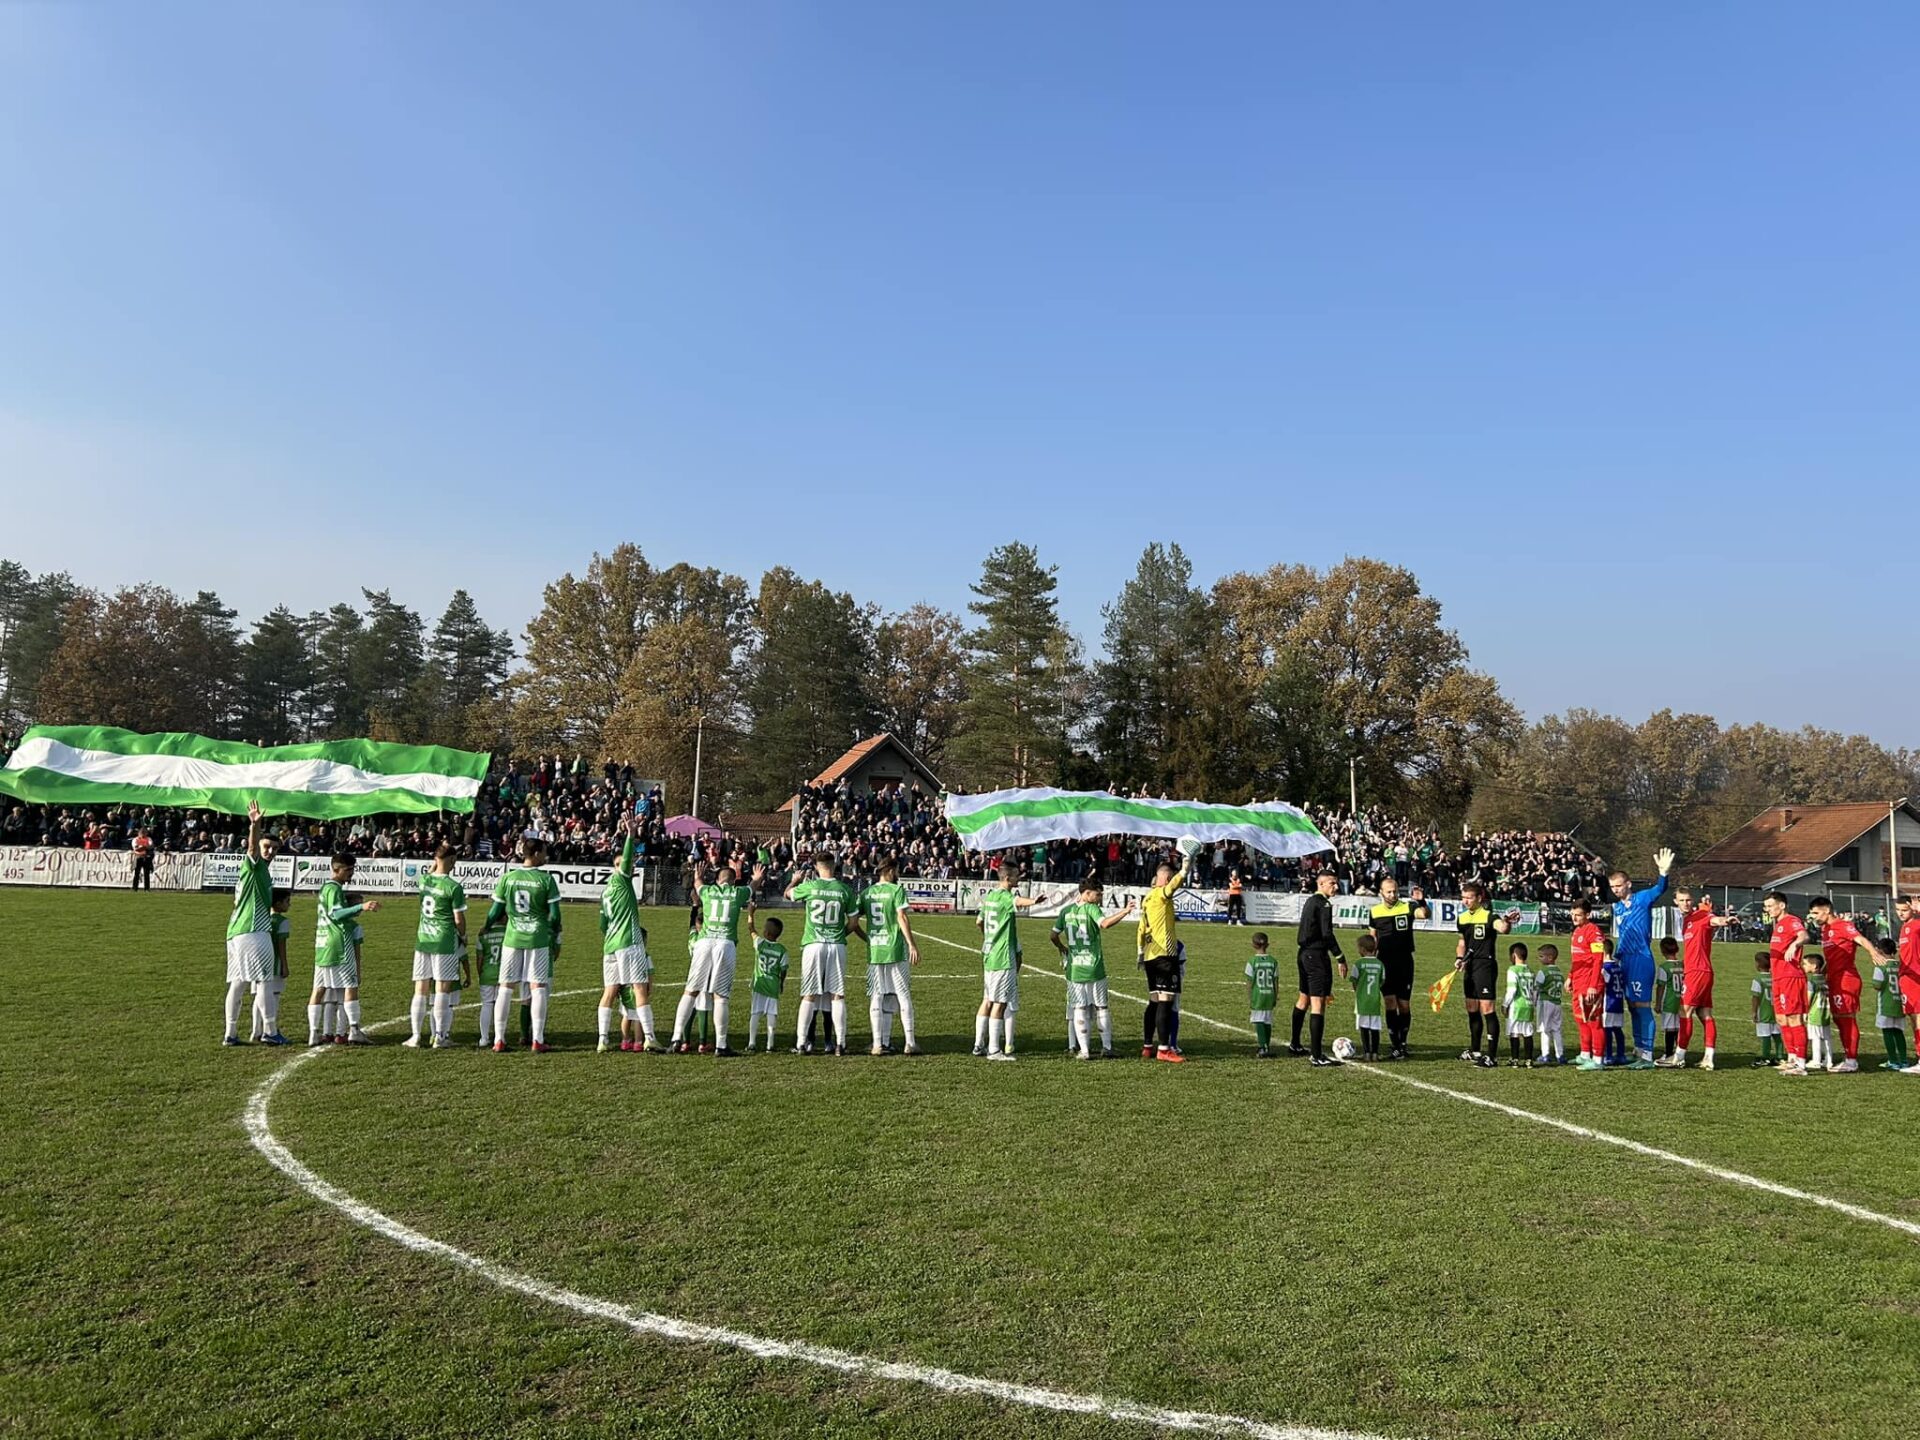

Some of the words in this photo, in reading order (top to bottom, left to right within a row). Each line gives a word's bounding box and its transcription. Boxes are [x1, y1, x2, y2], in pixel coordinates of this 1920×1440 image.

[9, 849, 28, 861] 127
[33, 850, 62, 872] 20
[64, 851, 123, 864] GODINA
[3, 868, 25, 879] 495
[354, 865, 371, 873] SKOG
[452, 866, 501, 878] LUKAVAC
[918, 883, 951, 892] PROM
[422, 895, 436, 918] 8
[708, 899, 731, 923] 11
[810, 899, 842, 925] 20
[871, 902, 886, 926] 5
[1065, 922, 1090, 946] 14
[1367, 974, 1377, 995] 7
[1631, 981, 1643, 992] 12
